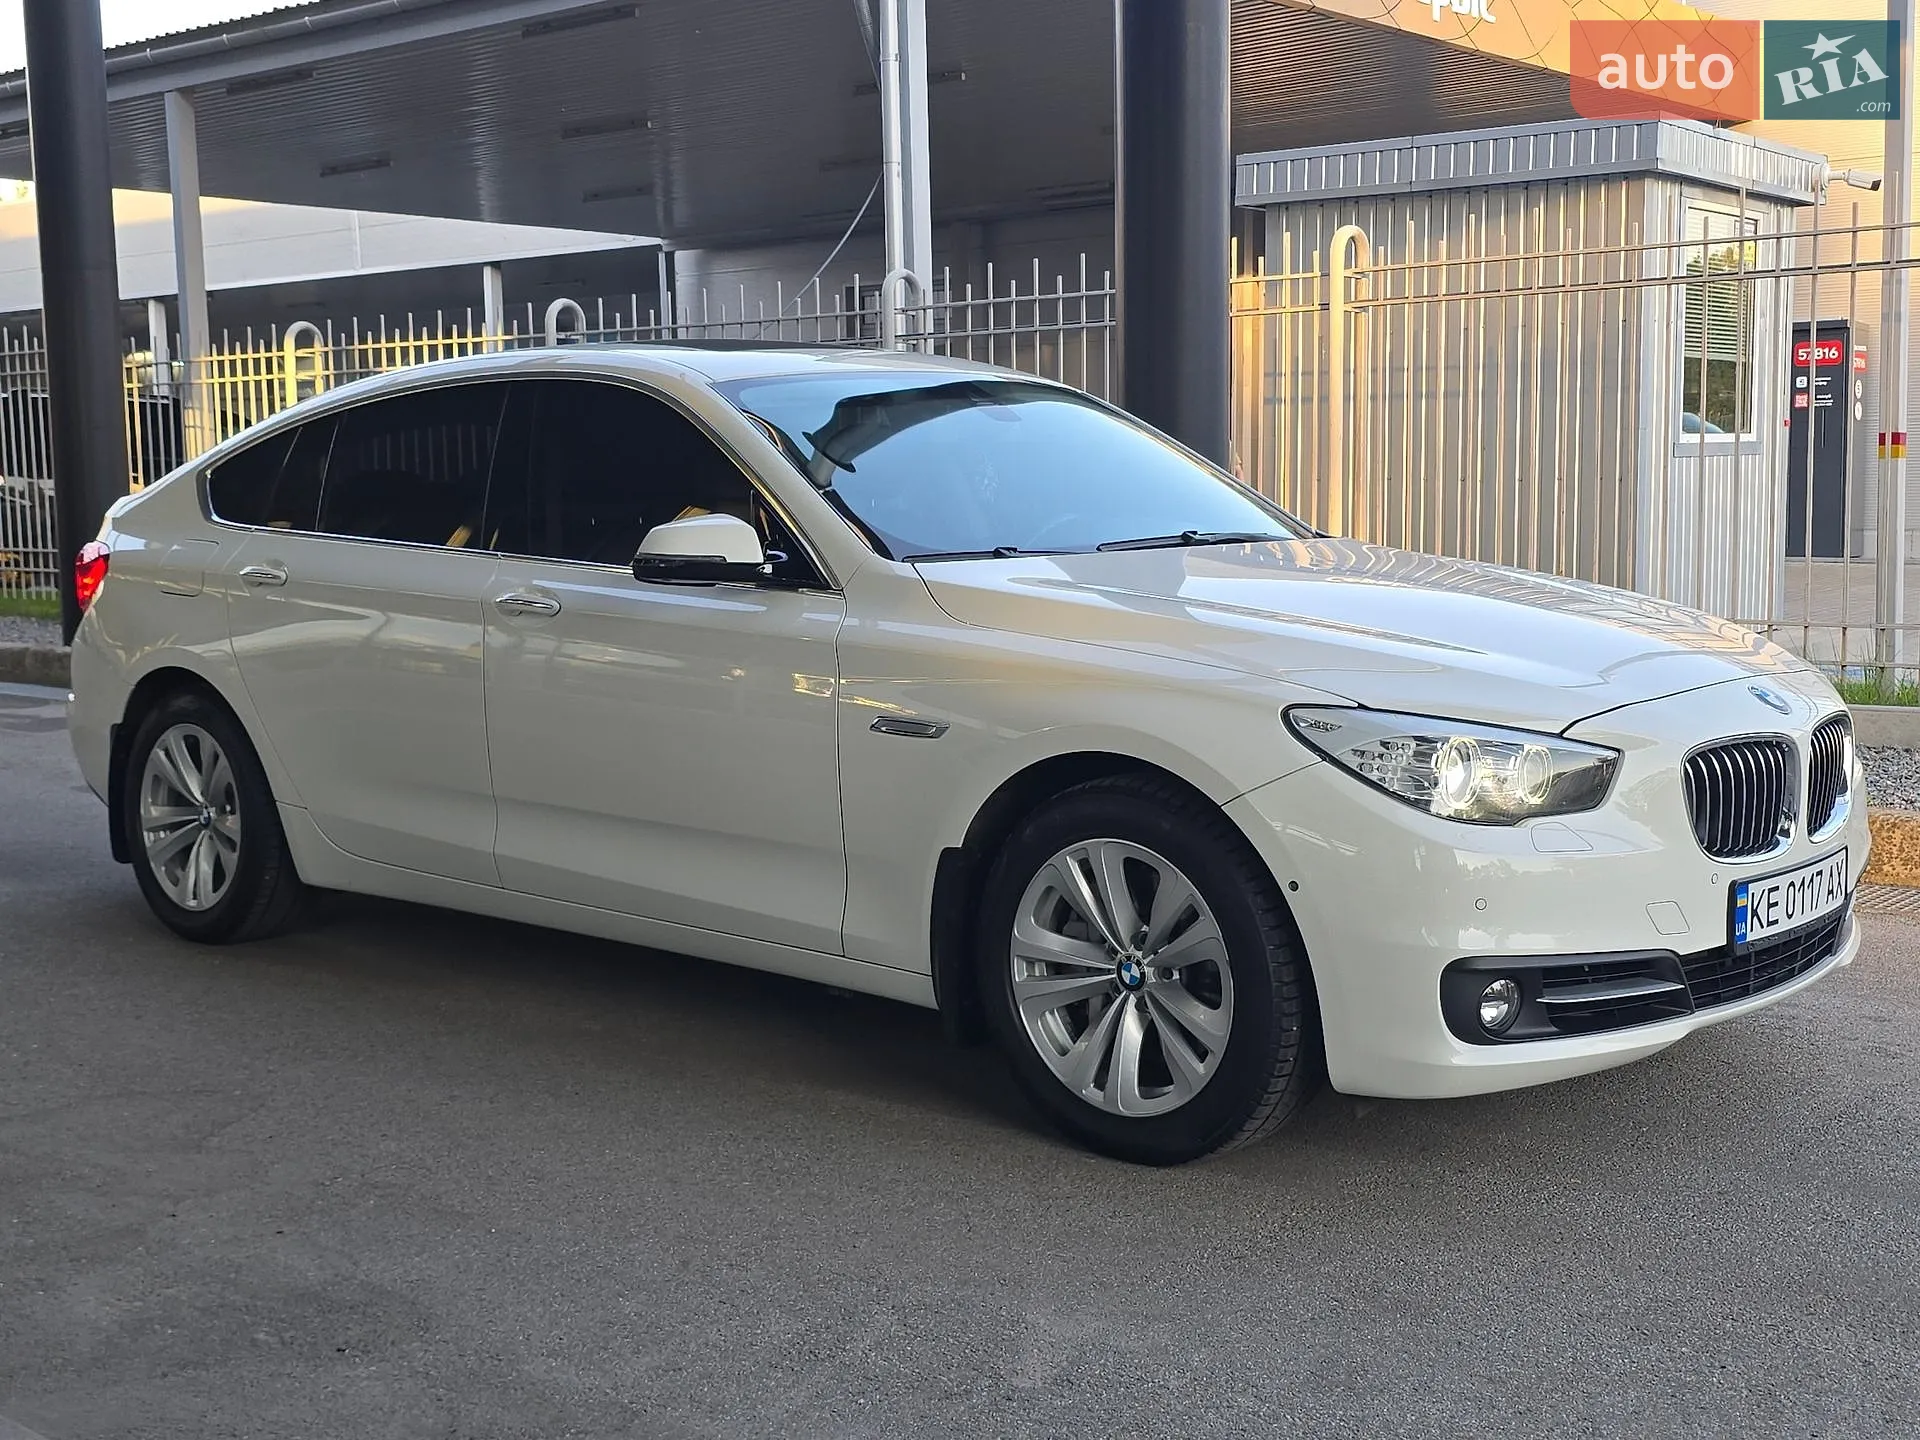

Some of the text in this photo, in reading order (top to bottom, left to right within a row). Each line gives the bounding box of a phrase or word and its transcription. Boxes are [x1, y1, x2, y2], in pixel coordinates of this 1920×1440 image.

[1750, 885, 1780, 933] KE
[1785, 869, 1824, 920] 0117
[1826, 859, 1844, 904] AX
[1735, 922, 1746, 936] UA
